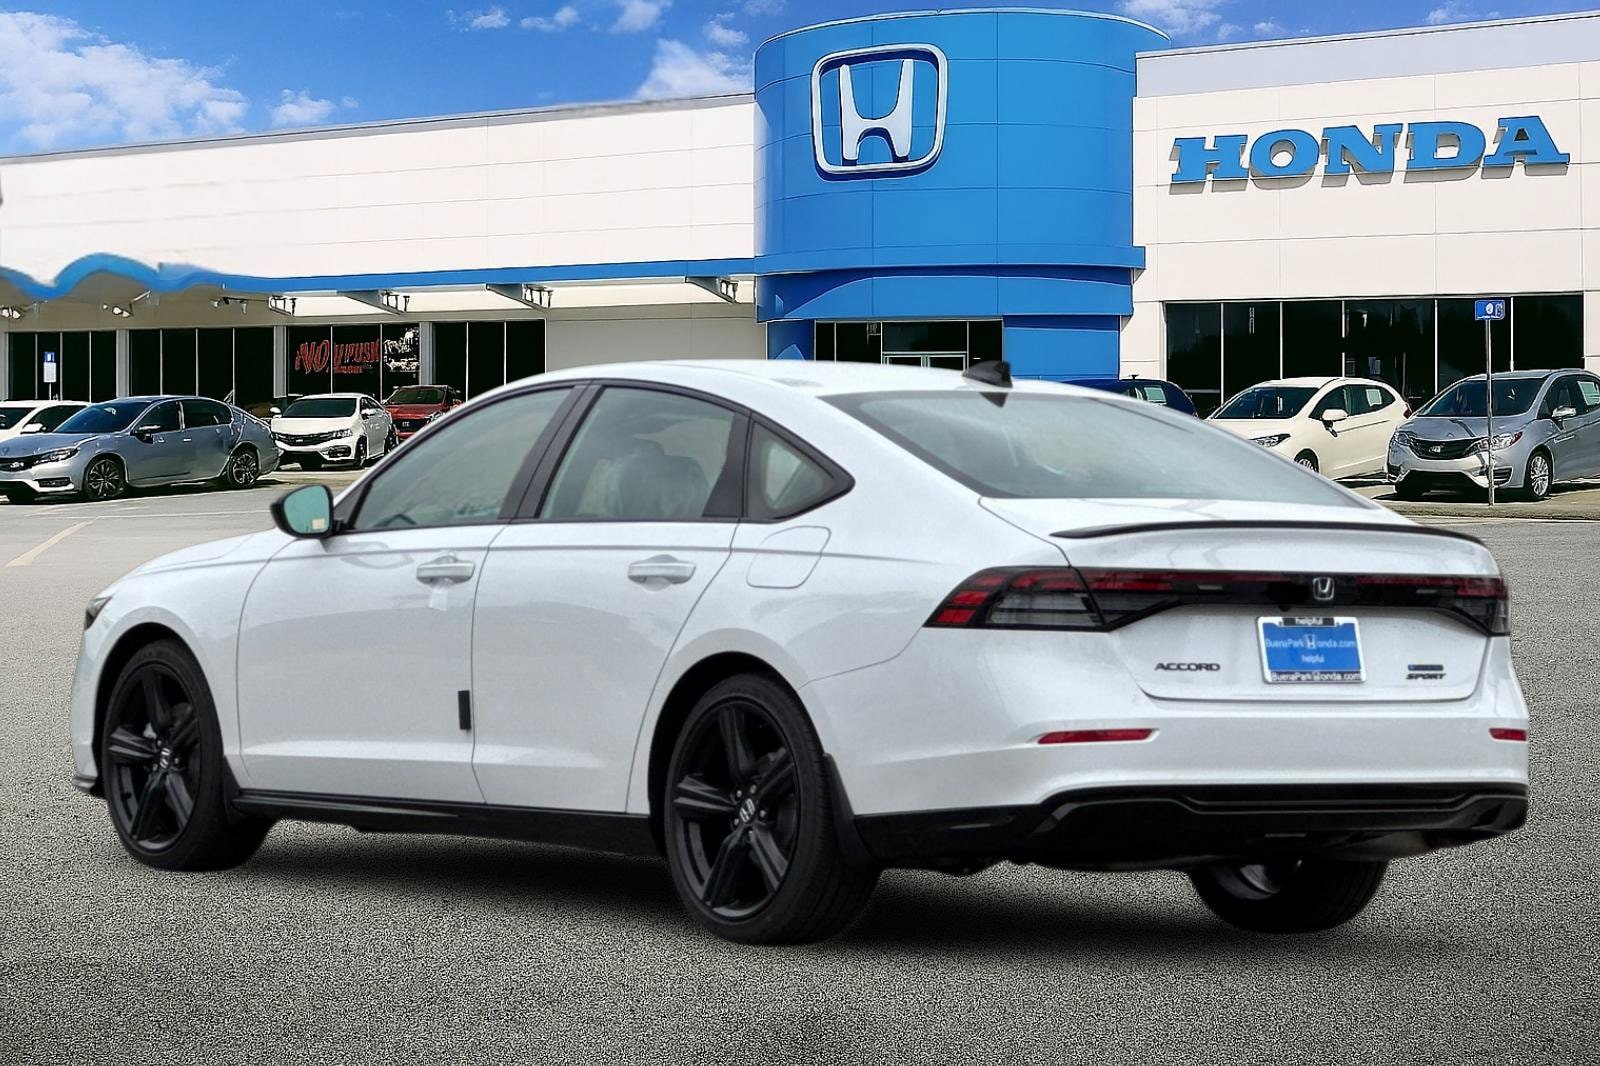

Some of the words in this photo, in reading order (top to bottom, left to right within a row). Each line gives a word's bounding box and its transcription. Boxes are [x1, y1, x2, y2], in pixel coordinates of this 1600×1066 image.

[1170, 115, 1571, 184] HONDA
[1295, 617, 1323, 626] helpful
[1154, 662, 1221, 672] ACCORD
[1406, 672, 1447, 680] SPORT
